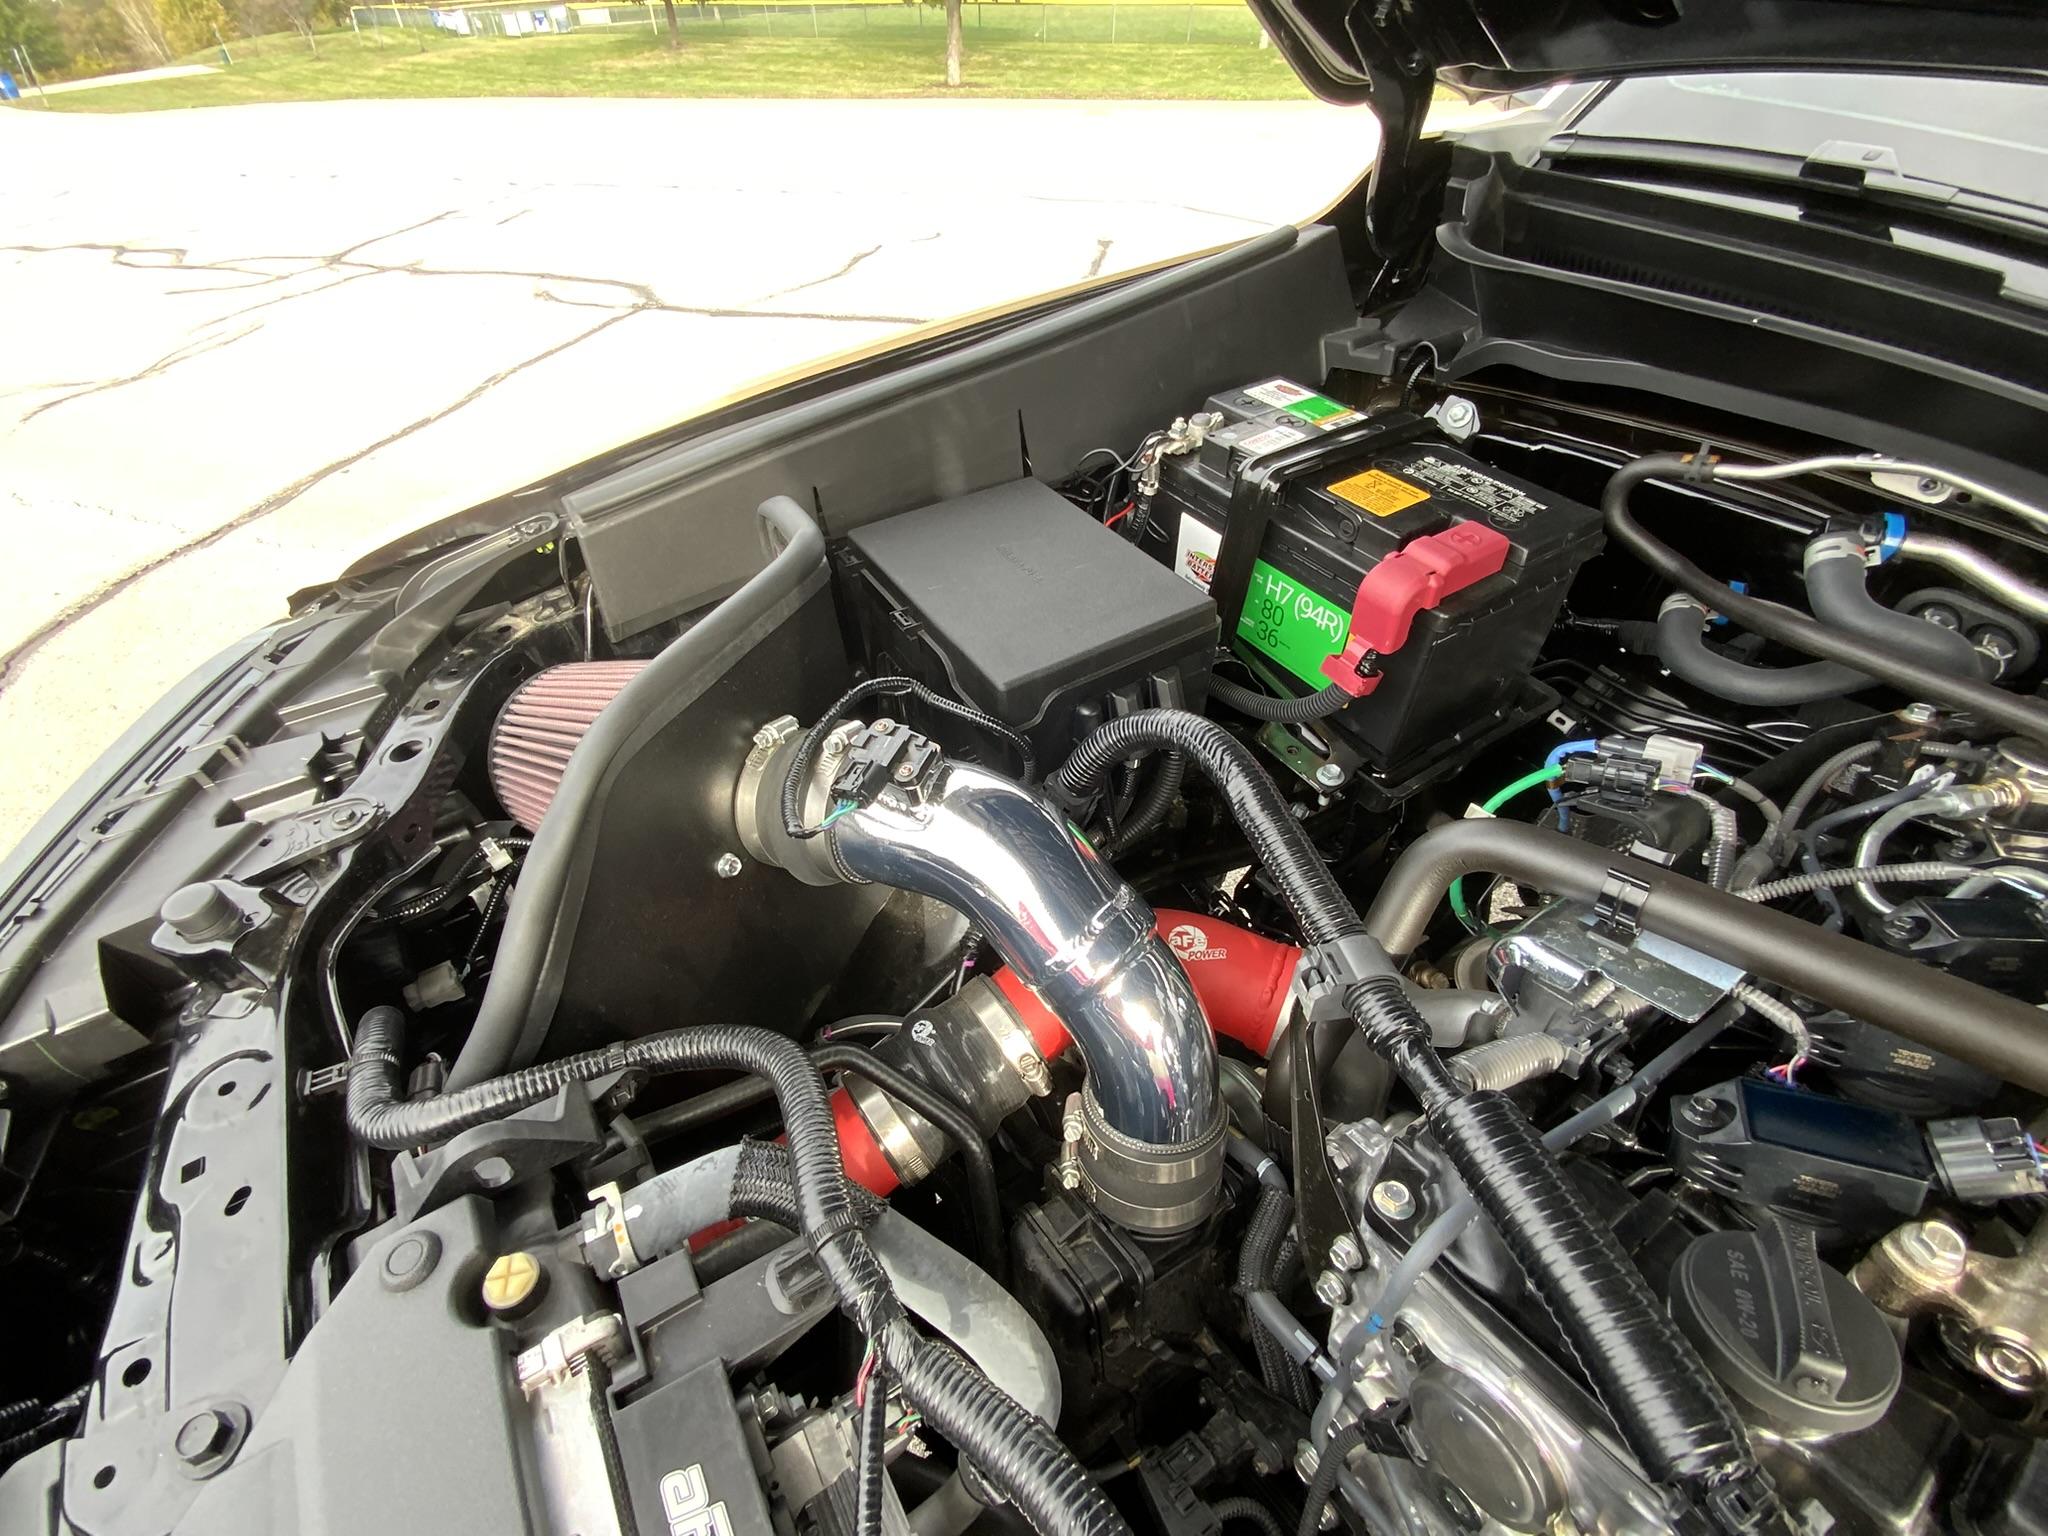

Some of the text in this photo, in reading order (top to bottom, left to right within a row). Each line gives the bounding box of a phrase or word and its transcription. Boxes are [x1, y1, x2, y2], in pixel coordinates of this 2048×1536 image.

[1186, 549, 1214, 571] INTERS
[1261, 598, 1285, 627] 80
[1265, 574, 1344, 643] H7 (94R)
[1256, 620, 1279, 648] 36
[1187, 948, 1227, 961] POWER
[1727, 1249, 1759, 1339] SAE 0W-20
